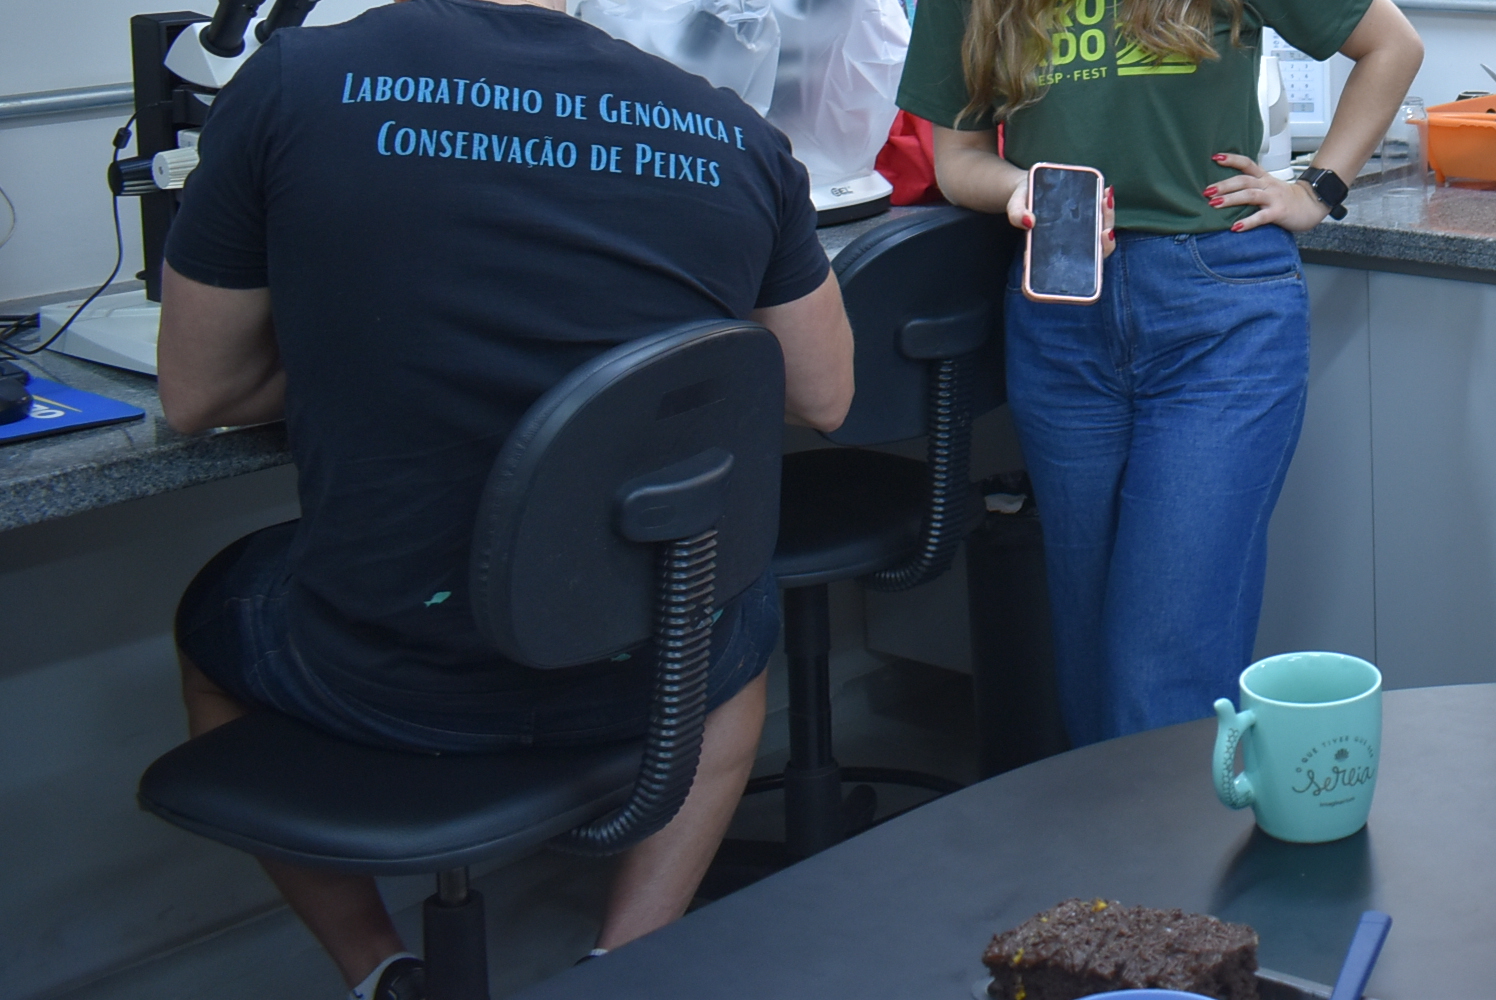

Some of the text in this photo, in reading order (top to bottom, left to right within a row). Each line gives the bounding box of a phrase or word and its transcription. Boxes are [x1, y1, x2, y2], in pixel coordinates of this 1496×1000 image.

[1074, 67, 1108, 82] FEST
[342, 73, 746, 151] LABORATÓRIO DE GENÔMICA E
[378, 121, 721, 188] CONSERVAÇÃO DE PEIXES
[1292, 766, 1375, 797] sereia
